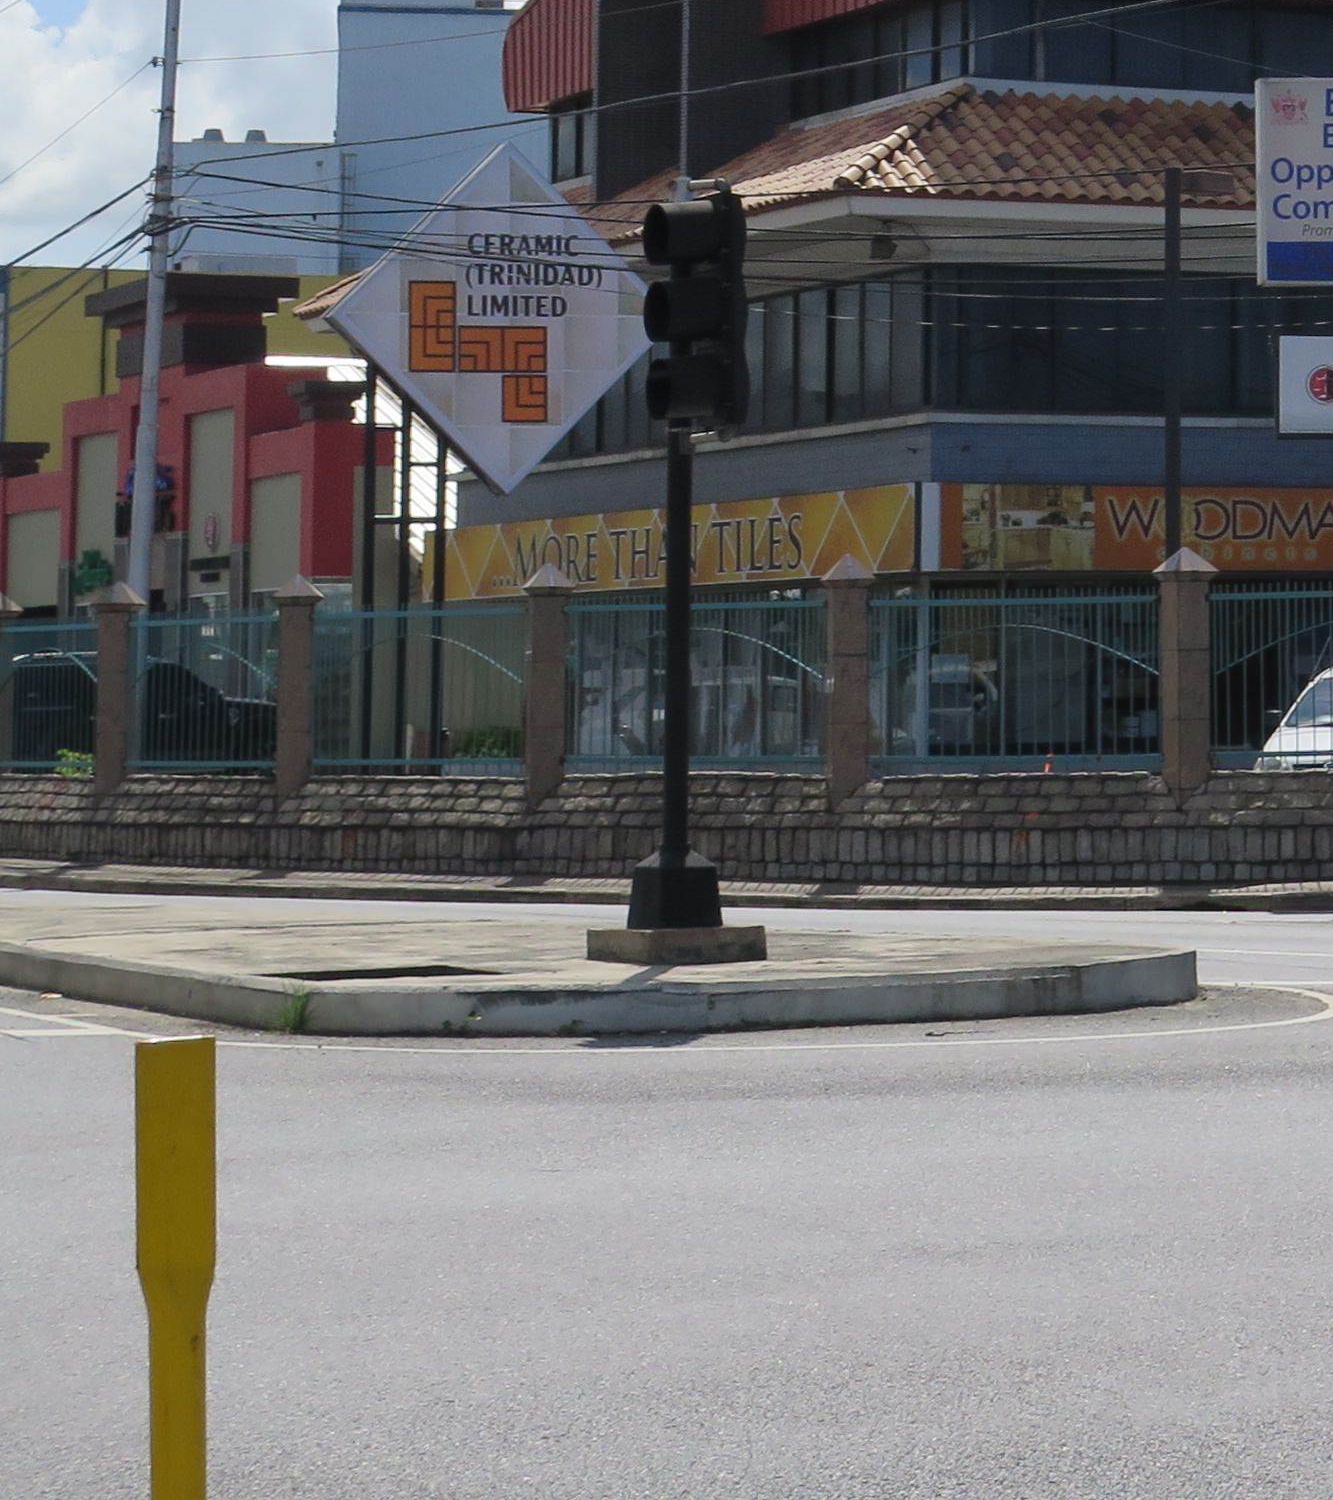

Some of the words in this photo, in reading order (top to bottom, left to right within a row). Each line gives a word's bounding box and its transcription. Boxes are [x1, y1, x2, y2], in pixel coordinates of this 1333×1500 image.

[467, 232, 579, 257] CERAMIC
[465, 263, 603, 288] (TRINIDAD)
[467, 294, 568, 317] LIMITED
[711, 513, 803, 575] TILES
